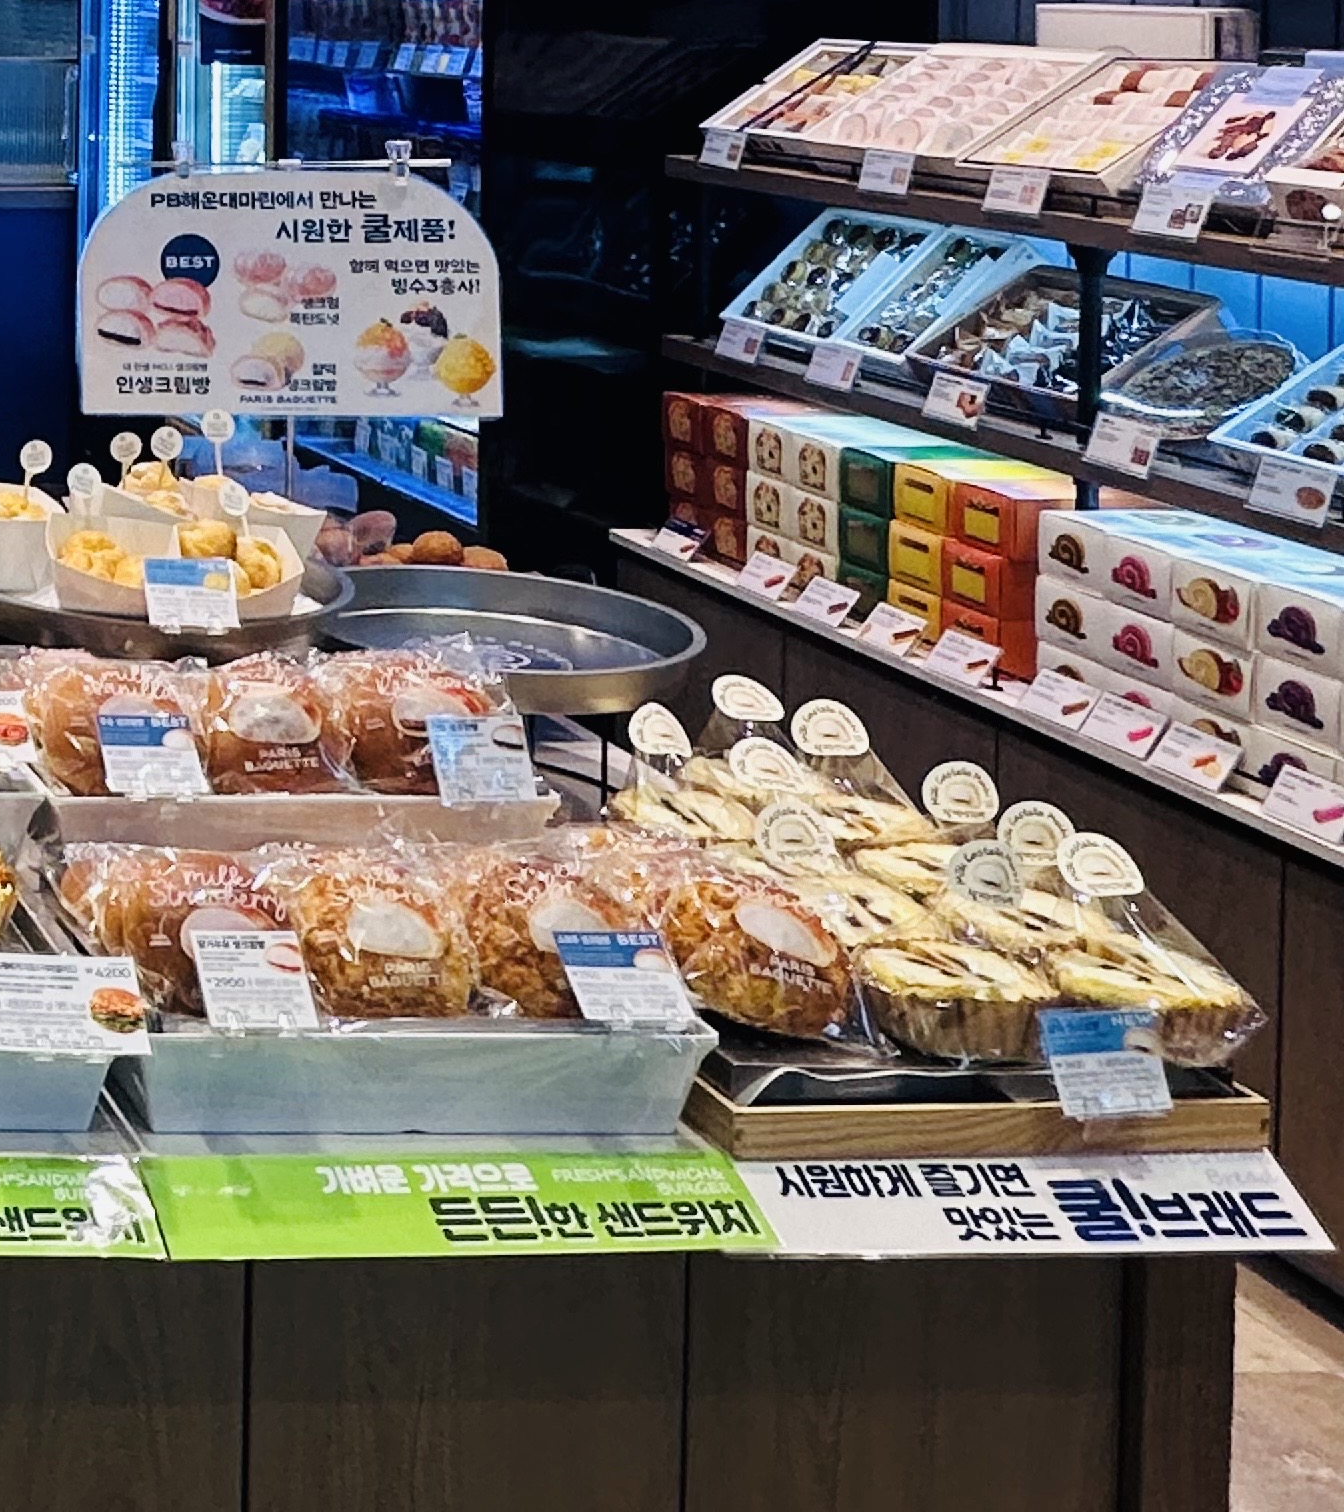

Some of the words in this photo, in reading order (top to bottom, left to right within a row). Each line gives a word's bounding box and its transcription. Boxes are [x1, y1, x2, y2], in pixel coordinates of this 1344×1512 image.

[320, 190, 377, 210] 만나는
[276, 218, 353, 244] 시원한
[361, 212, 456, 244] 쿨제품!
[165, 256, 215, 269] BEST
[434, 258, 481, 274] 맛있는
[116, 375, 211, 395] 인생크림빵
[240, 394, 273, 404] PARIS
[276, 394, 337, 405] BAGUETTE
[259, 747, 301, 758] PARIS
[244, 758, 320, 772] BAGUETTE
[183, 864, 252, 888] milk
[616, 933, 659, 947] BEST
[1110, 1013, 1152, 1026] NEW
[315, 1163, 412, 1196] 가벼운
[413, 1162, 541, 1195] 가격으로
[775, 1162, 923, 1199] 시원하게
[918, 1162, 1036, 1199] 즐기면
[429, 1195, 594, 1242] 든든!한
[597, 1200, 762, 1239] 샌드위치
[943, 1206, 1063, 1243] 맛있는
